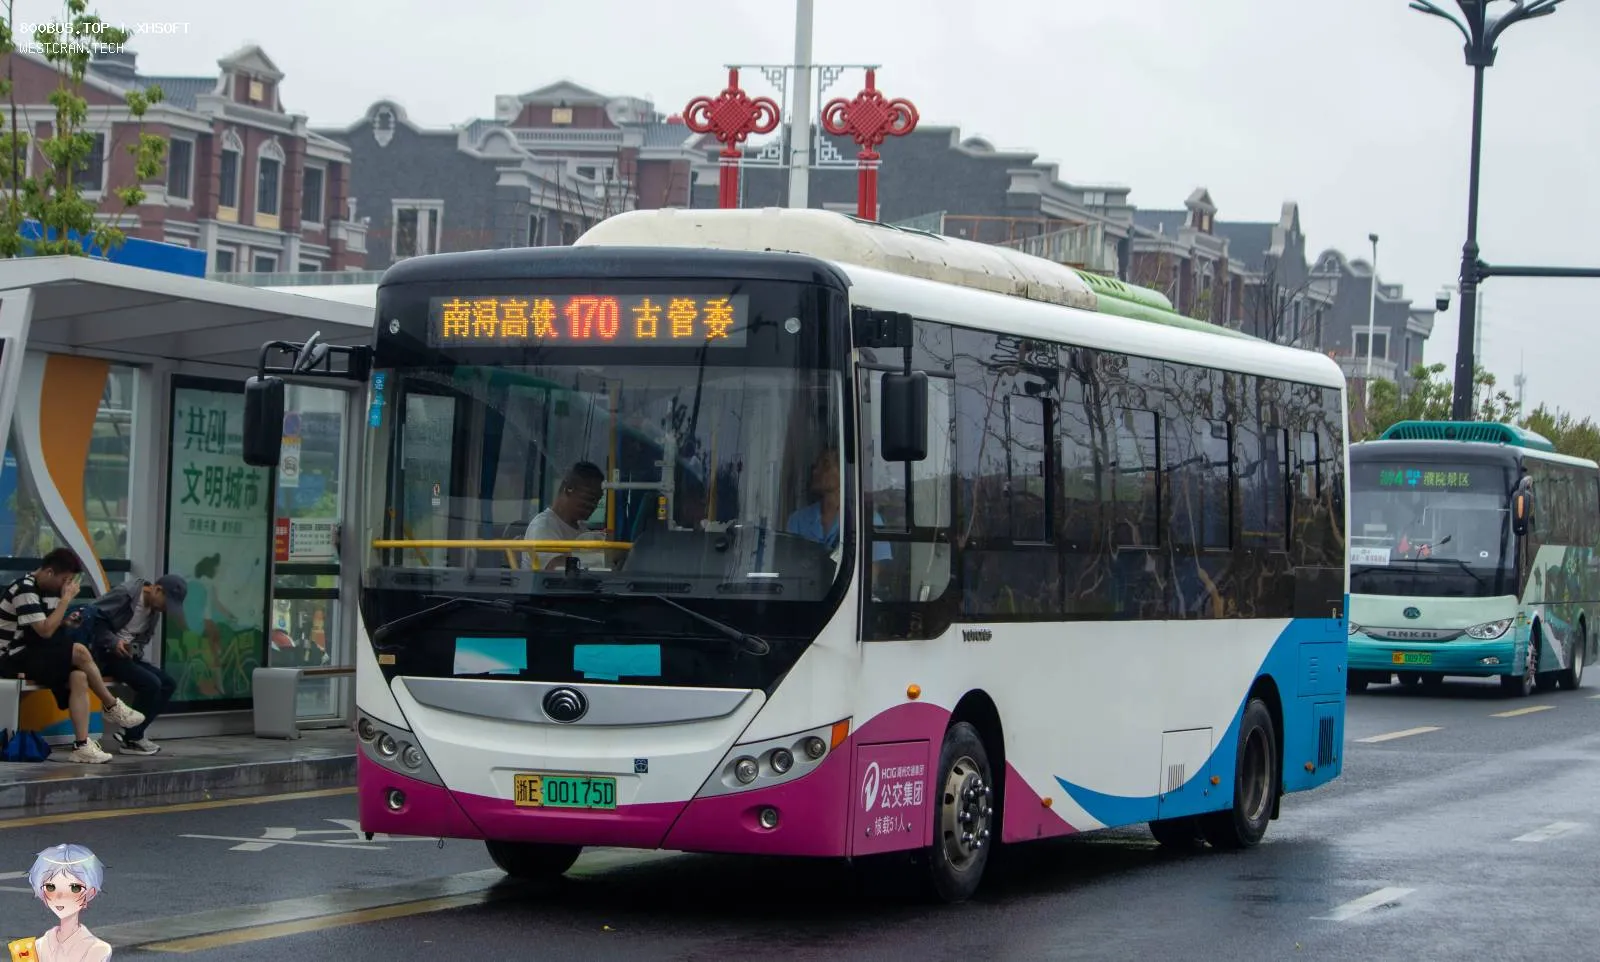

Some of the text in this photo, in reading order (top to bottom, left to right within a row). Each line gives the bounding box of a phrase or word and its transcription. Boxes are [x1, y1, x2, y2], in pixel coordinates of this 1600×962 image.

[564, 296, 619, 338] 170
[632, 298, 734, 338] 古管委
[184, 406, 227, 454] 共创
[181, 461, 262, 510] 文明城市
[1387, 630, 1438, 638] ANKAI
[881, 780, 924, 809] 公交集团
